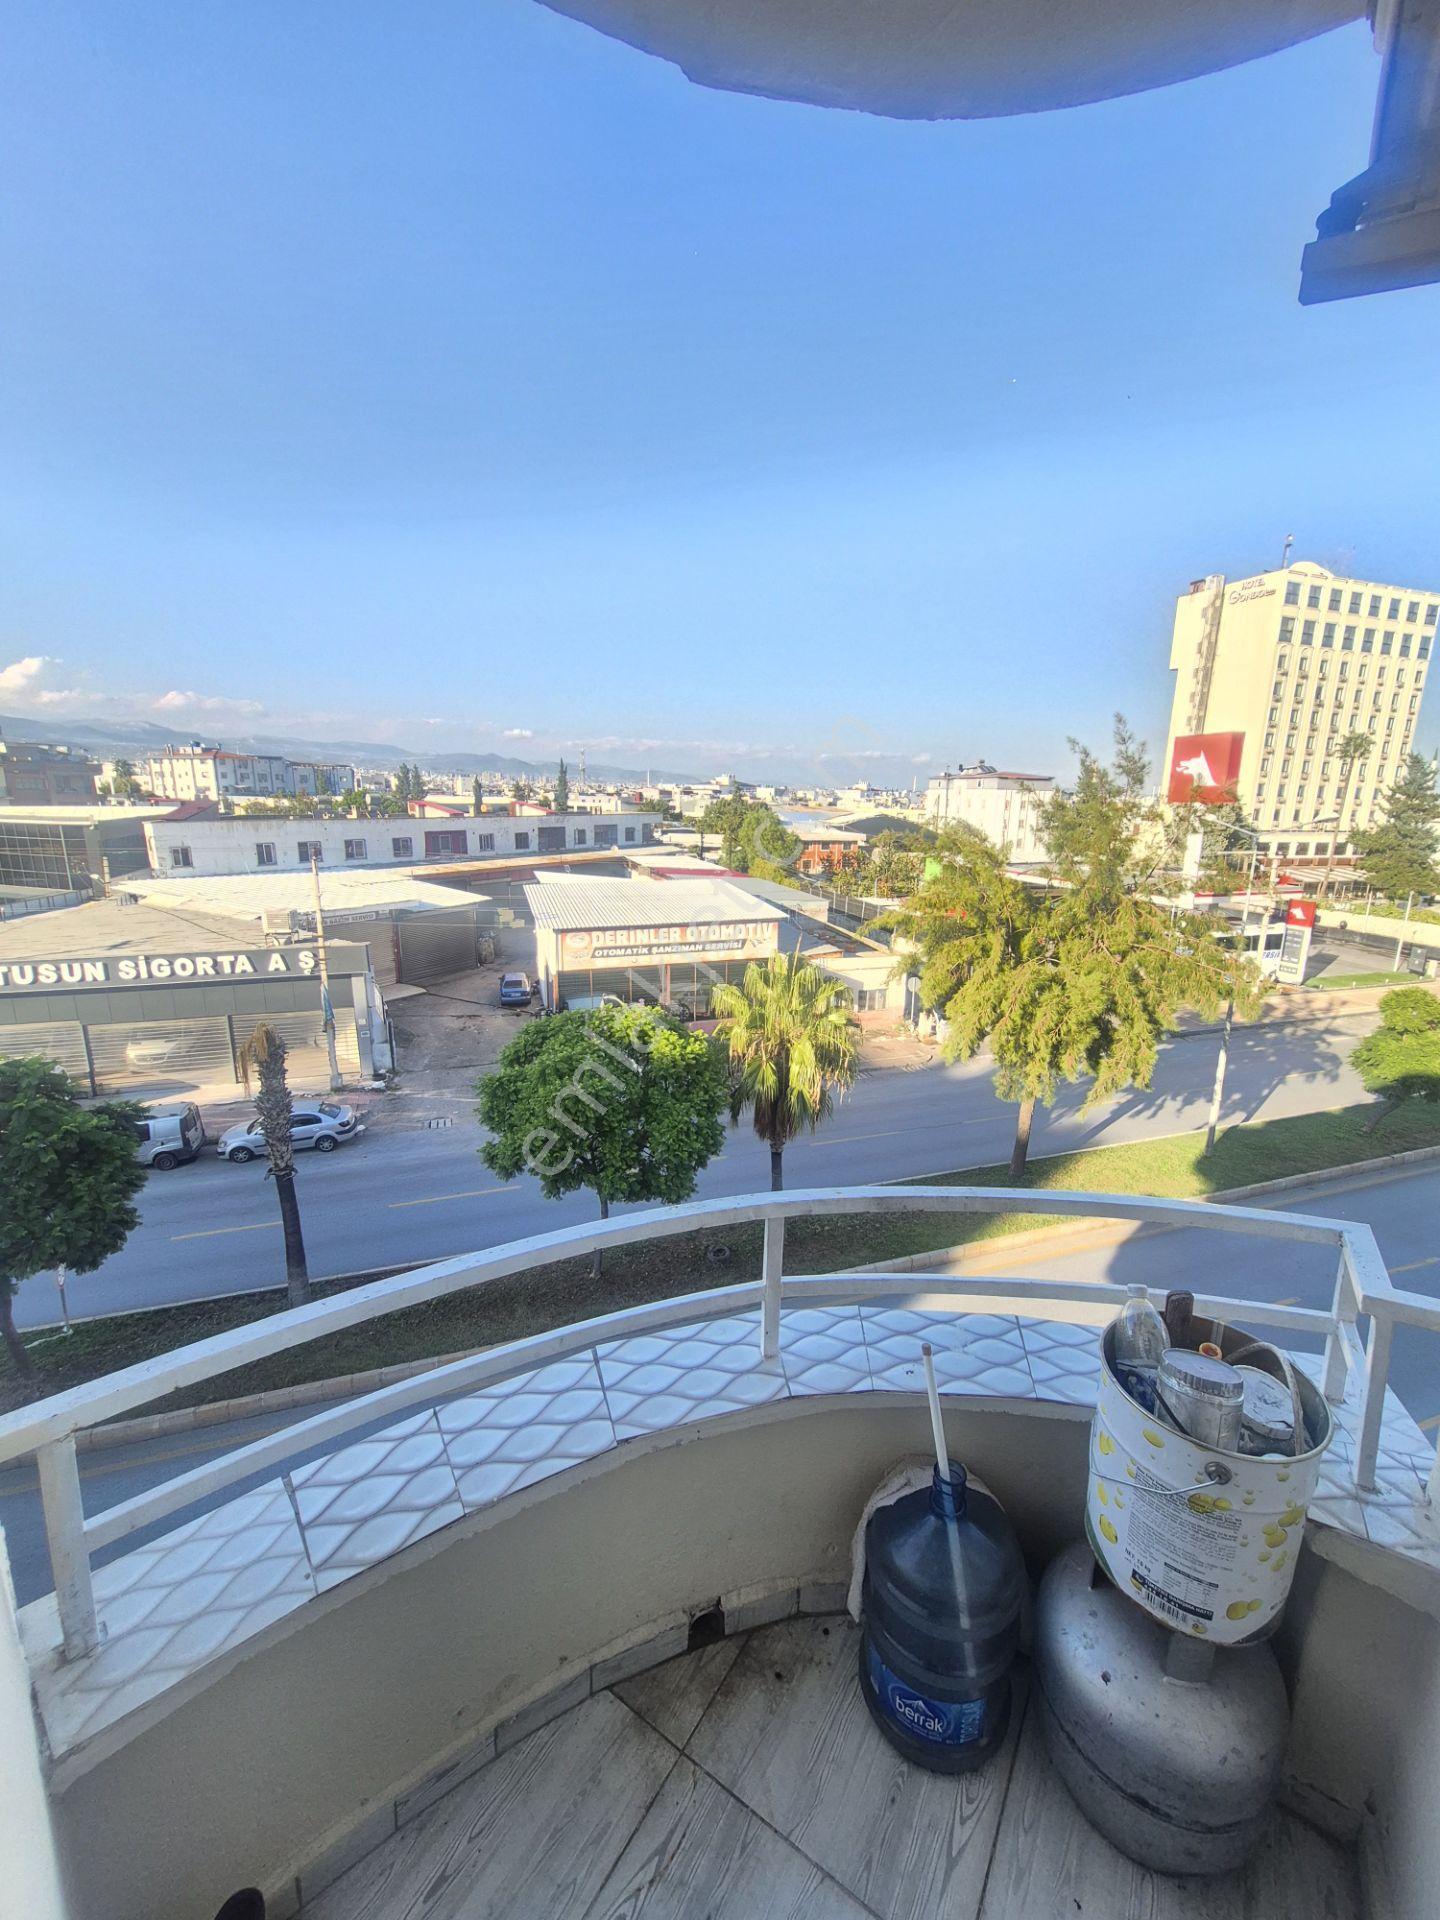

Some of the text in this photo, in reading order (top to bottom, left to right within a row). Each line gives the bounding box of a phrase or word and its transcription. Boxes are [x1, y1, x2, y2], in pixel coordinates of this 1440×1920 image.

[117, 954, 254, 980] SİGORTA
[267, 953, 287, 972] A
[298, 950, 316, 975] Ş
[594, 944, 649, 957] OTOMATİK
[896, 1695, 943, 1732] berrak
